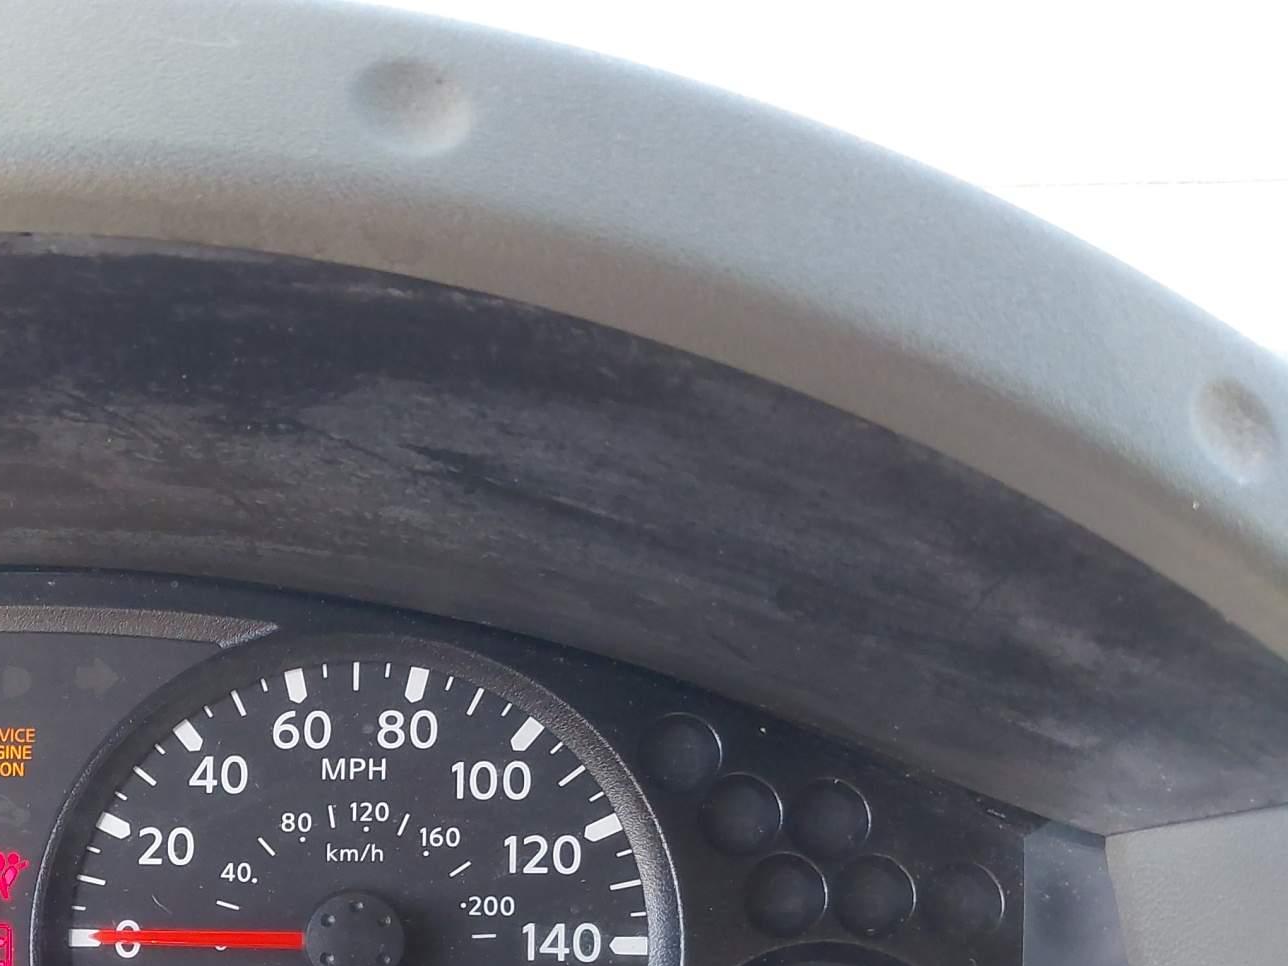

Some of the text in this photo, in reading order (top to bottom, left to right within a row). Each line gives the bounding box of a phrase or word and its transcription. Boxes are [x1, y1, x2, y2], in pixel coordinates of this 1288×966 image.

[272, 710, 332, 750] 60
[377, 709, 438, 750] 80
[188, 755, 248, 795] 40
[321, 757, 387, 781] MPH
[451, 760, 532, 801] 100
[281, 812, 312, 834] 80
[350, 801, 390, 823] 120
[138, 826, 195, 866] 20
[326, 843, 384, 863] km/h
[419, 827, 461, 848] 160
[504, 833, 582, 875] 120
[468, 895, 515, 917] 200
[115, 919, 141, 959] 0
[521, 922, 601, 963] 140
